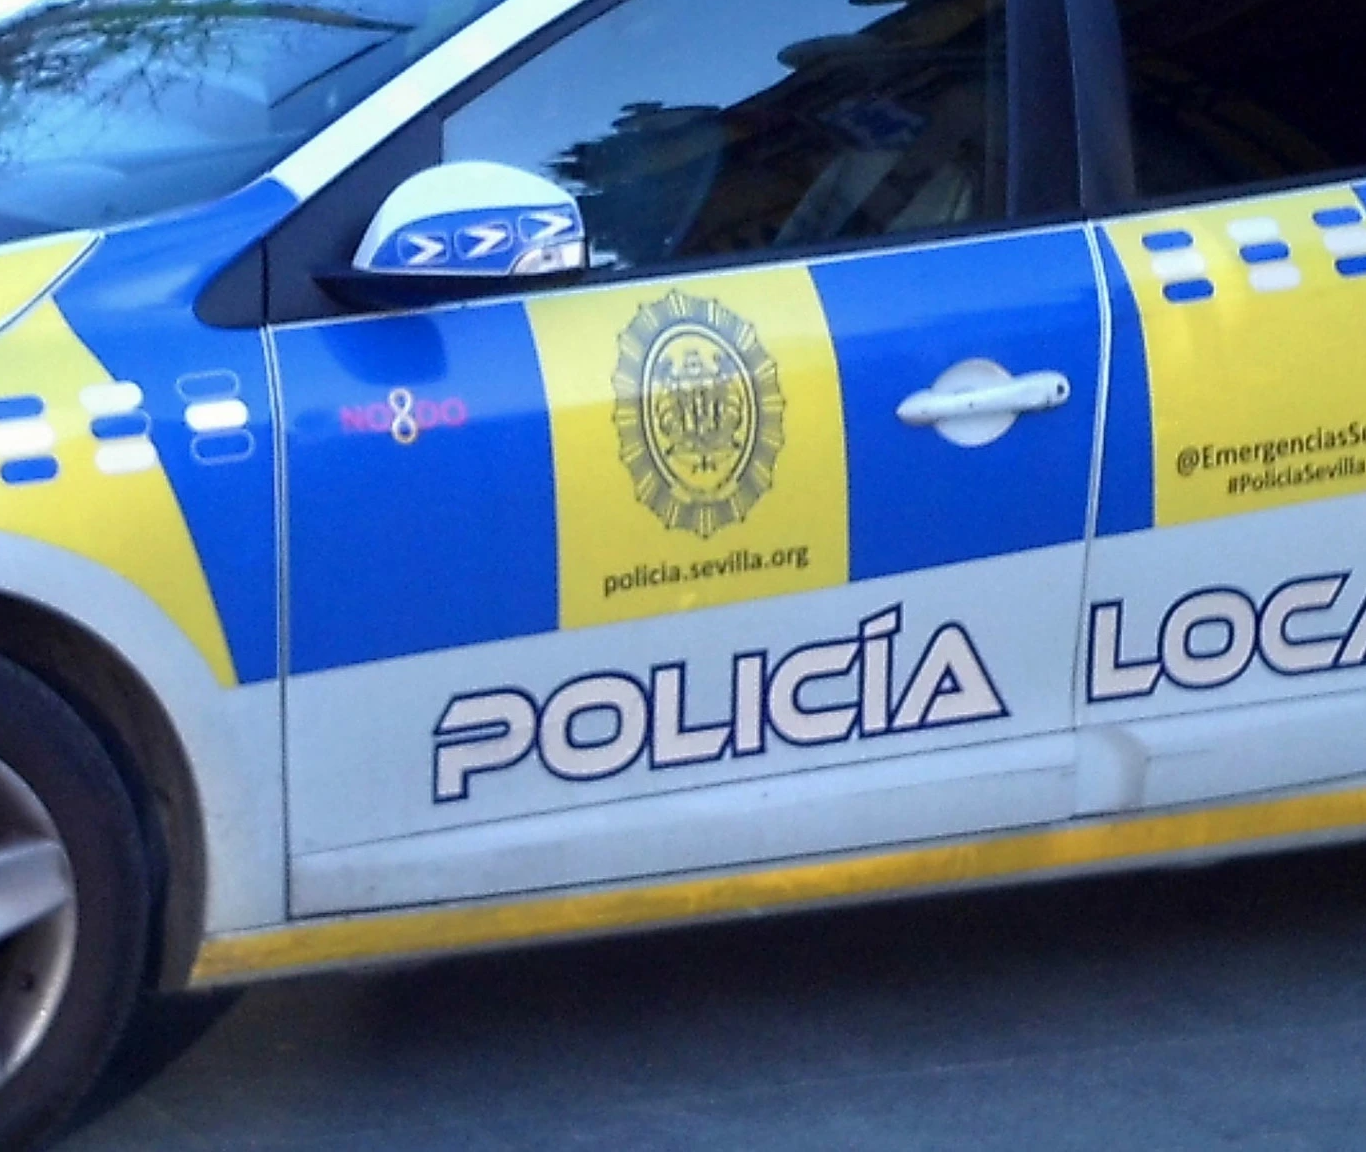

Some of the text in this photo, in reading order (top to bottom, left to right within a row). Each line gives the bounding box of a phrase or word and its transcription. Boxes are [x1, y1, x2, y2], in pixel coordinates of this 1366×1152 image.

[1227, 455, 1366, 495] #PoliciaSevilla
[603, 545, 810, 598] policia.sevilla.org
[433, 602, 1011, 805] POLICÍA
